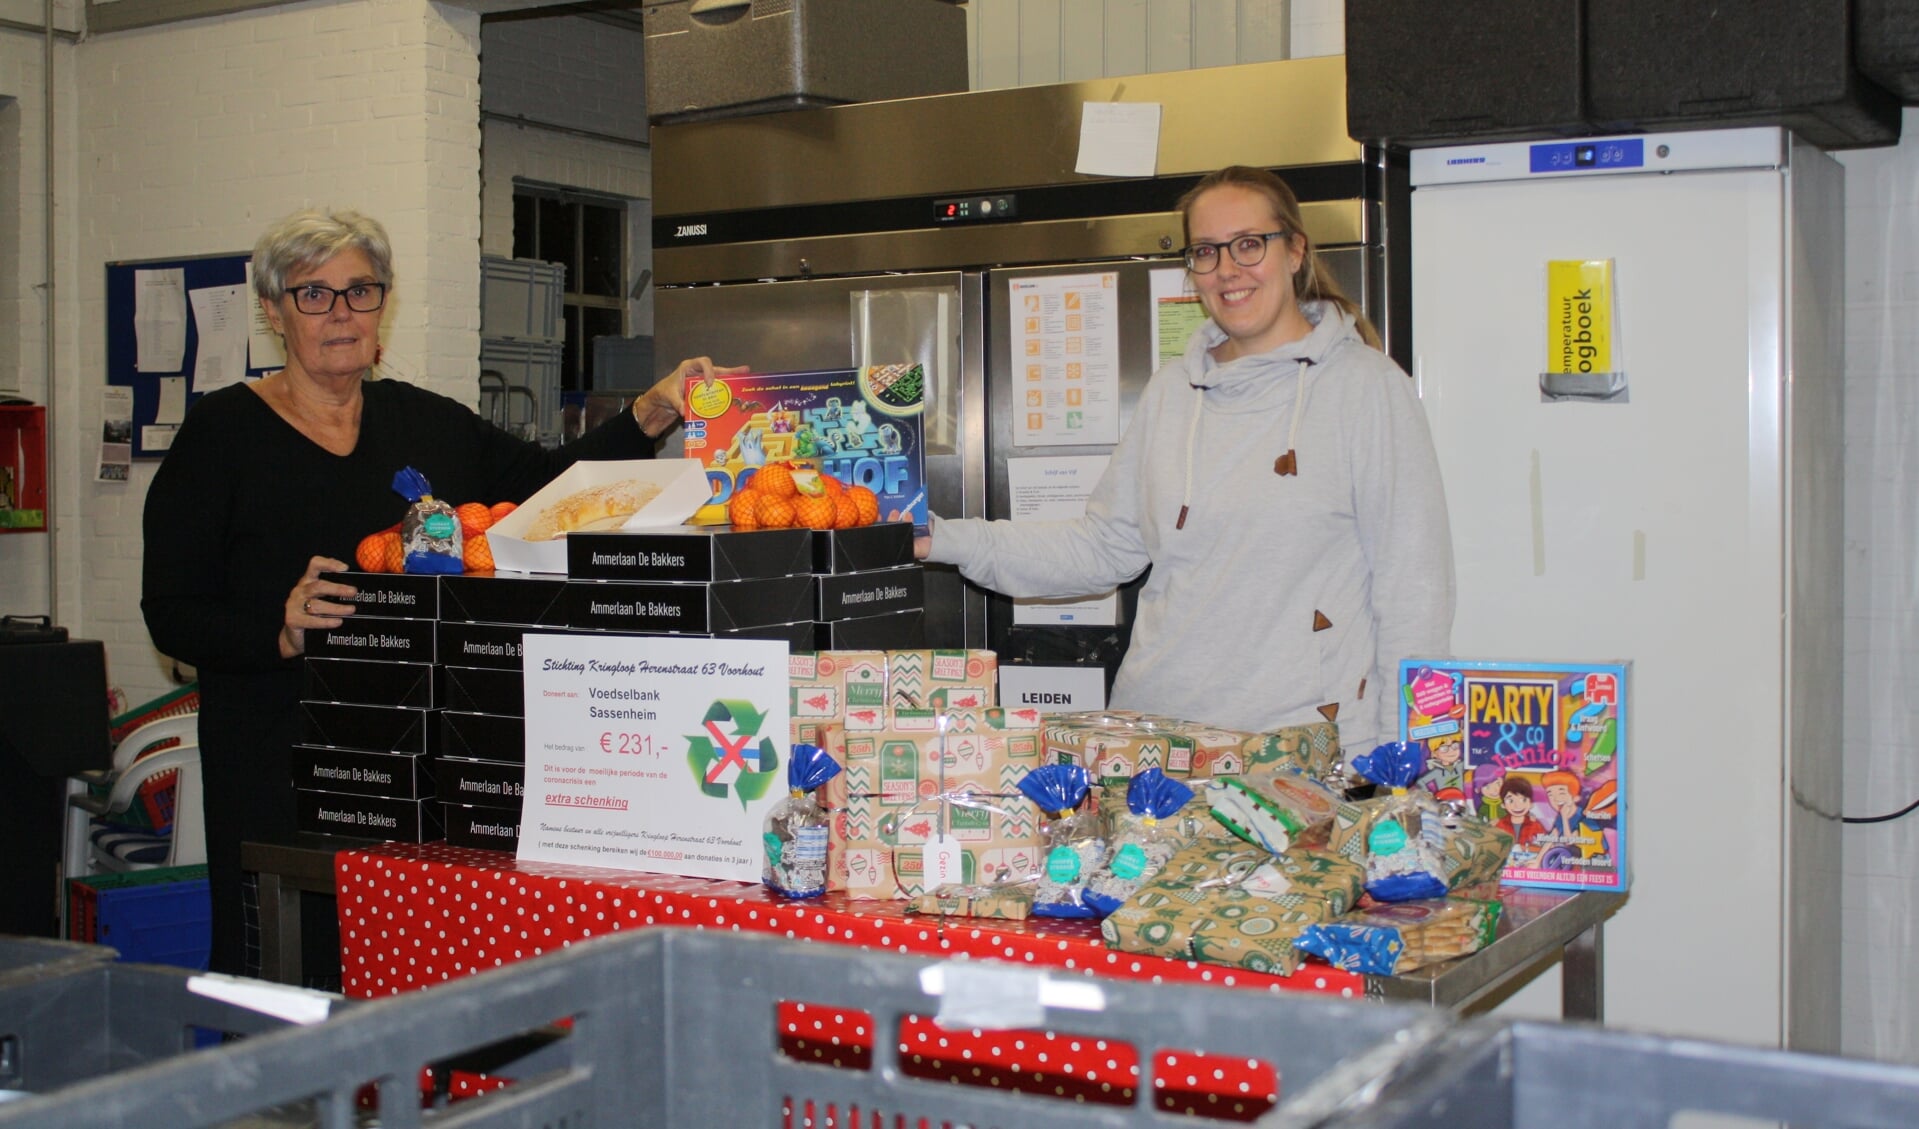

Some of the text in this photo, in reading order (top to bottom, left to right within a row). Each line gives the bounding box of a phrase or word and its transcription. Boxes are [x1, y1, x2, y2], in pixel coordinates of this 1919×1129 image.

[947, 204, 956, 216] 2
[674, 224, 707, 237] ZANUSSI
[1562, 297, 1573, 374] emperatuur
[1573, 288, 1597, 373] ogboek
[592, 552, 685, 567] Ammerlaan De Bakkers
[378, 590, 387, 603] De
[388, 590, 416, 605] Bakkers
[842, 586, 907, 605] Ammerlaan De Bakkers
[590, 601, 681, 617] Ammerlaan De Bakkers
[327, 633, 410, 648] Ammerlaan De Bakkers
[463, 641, 503, 656] Ammerlaan
[505, 643, 516, 656] De
[542, 658, 765, 676] Stichting Kringloop Herenstraat 63 Voorhout
[543, 690, 565, 698] Doneert
[588, 688, 660, 701] Voedselbank
[1022, 693, 1072, 705] LEIDEN
[590, 706, 656, 720] Sassenheim
[1470, 684, 1553, 726] PARTY
[555, 744, 574, 752] bedrag
[600, 732, 668, 758] € 231,-
[1494, 722, 1526, 760] &
[1491, 742, 1576, 777] Junior
[314, 764, 392, 784] Ammerlaan De Bakkers
[544, 764, 553, 772] Dit
[554, 765, 560, 773] is
[577, 766, 586, 774] de
[589, 768, 618, 777] moeilijke
[620, 770, 644, 778] periode
[460, 777, 500, 794] Ammerlaan
[503, 781, 513, 796] De
[543, 776, 583, 785] coronacrisis
[883, 780, 915, 791] SEASON'S
[545, 793, 629, 809] extra schenking
[318, 808, 397, 828] Ammerlaan De Bakkers
[470, 821, 513, 837] Ammerlaan
[555, 841, 569, 849] deze
[570, 842, 601, 853] schenking
[602, 846, 628, 854] bereiken
[630, 848, 639, 856] wij
[697, 854, 723, 862] donaties
[736, 857, 748, 865] jaar
